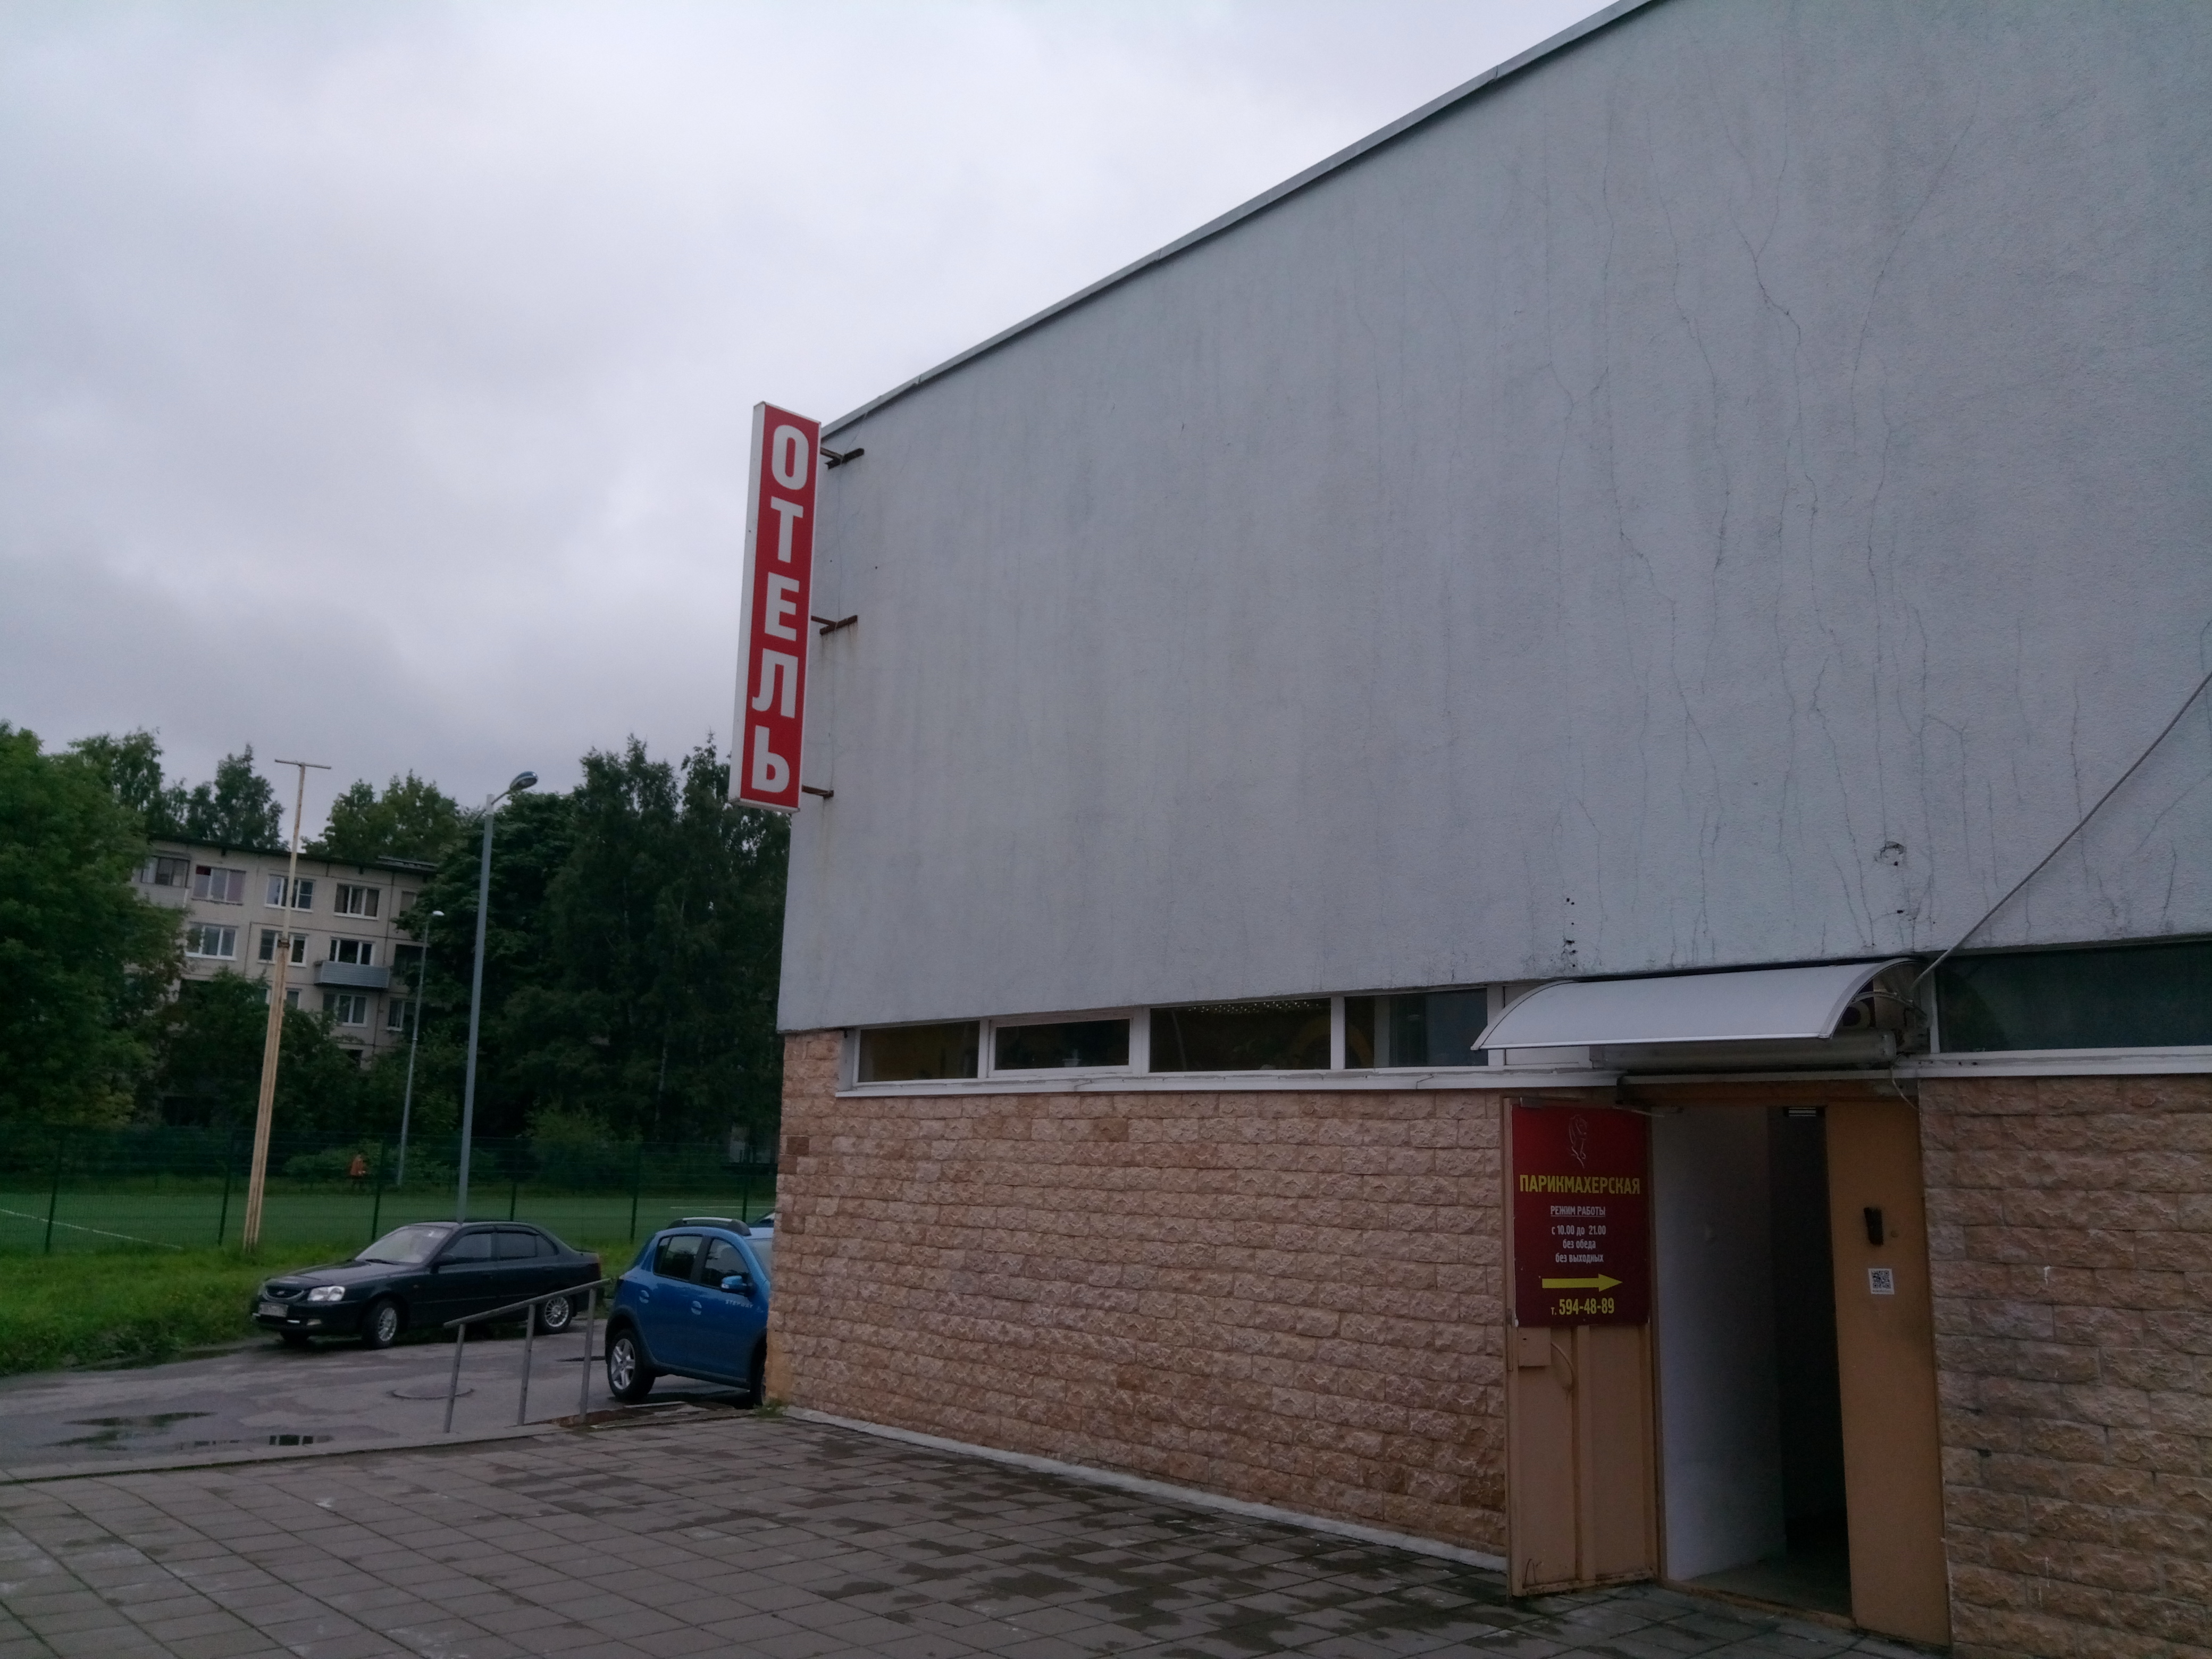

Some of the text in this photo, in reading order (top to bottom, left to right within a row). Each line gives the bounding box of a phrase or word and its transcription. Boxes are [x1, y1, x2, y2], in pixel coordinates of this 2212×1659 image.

[751, 424, 809, 793] ОТЕЛЬ
[1520, 1175, 1640, 1194] ПАРИКМАХЕРСКАЯ
[1551, 1205, 1606, 1217] РЕЖИМ РАБОТЫ
[1557, 1225, 1575, 1235] 10.00
[1577, 1226, 1585, 1236] до
[1588, 1225, 1606, 1235] 21.00
[1563, 1239, 1596, 1250] без обеда
[1555, 1253, 1604, 1264] без выходных
[1559, 1297, 1615, 1315] 594-48-89
